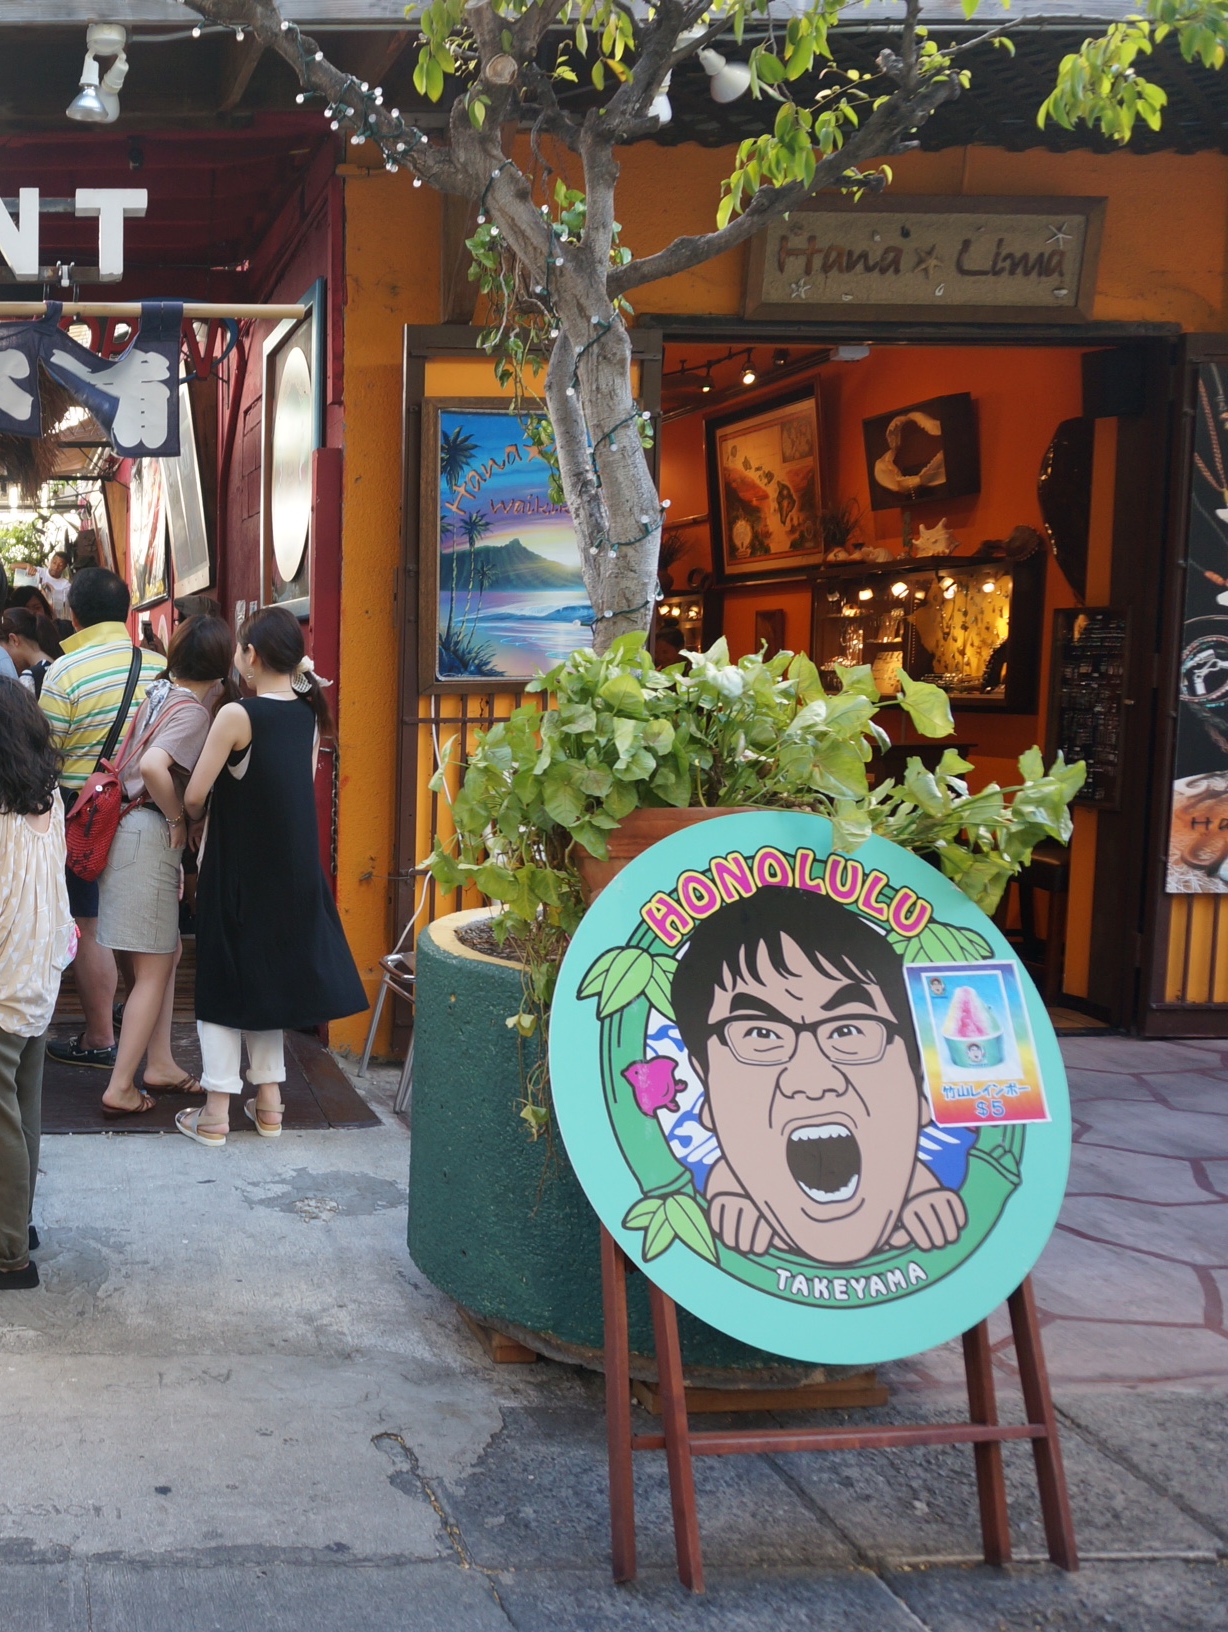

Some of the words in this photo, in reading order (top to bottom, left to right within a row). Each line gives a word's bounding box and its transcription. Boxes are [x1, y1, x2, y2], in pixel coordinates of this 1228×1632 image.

[777, 233, 903, 275] Hana
[955, 237, 1066, 277] Lima
[445, 443, 523, 516] Hana
[639, 844, 934, 948] HONOLULU
[942, 1082, 1030, 1099] 竹山レインボー
[975, 1100, 1006, 1117] $5
[775, 1261, 929, 1302] TAKEYAMA
